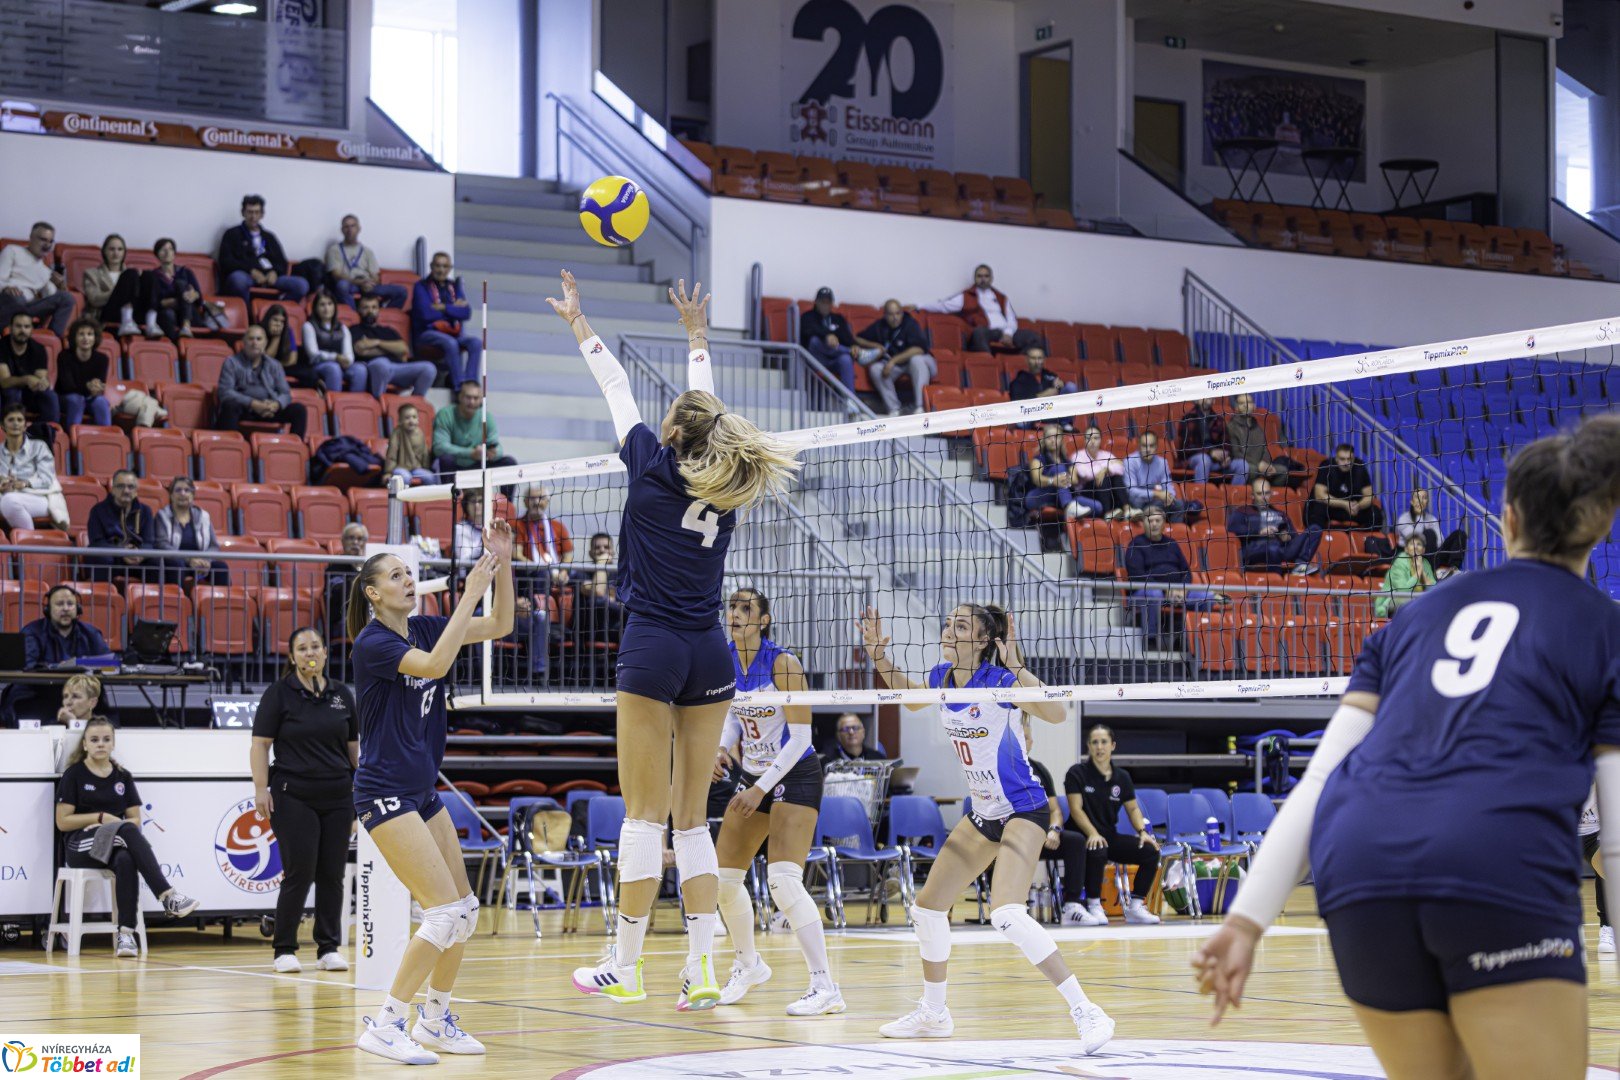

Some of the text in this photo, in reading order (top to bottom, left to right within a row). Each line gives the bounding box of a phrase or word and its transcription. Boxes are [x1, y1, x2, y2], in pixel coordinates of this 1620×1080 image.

[792, 0, 944, 121] 20
[63, 113, 145, 136] Continental
[845, 105, 935, 139] Eissmann
[203, 127, 282, 148] Continental
[845, 133, 935, 151] Group Automotive
[336, 140, 412, 160] Continental
[1423, 345, 1469, 361] TippmixPRO
[1206, 376, 1246, 391] TippmixPRO
[1020, 402, 1054, 415] TippmixPRO
[681, 500, 719, 548] 4
[1431, 601, 1520, 698] 9
[420, 685, 437, 718] 13
[740, 717, 761, 739] 13
[953, 740, 973, 766] 10
[374, 796, 401, 816] 13
[360, 861, 374, 959] TippmixPRO
